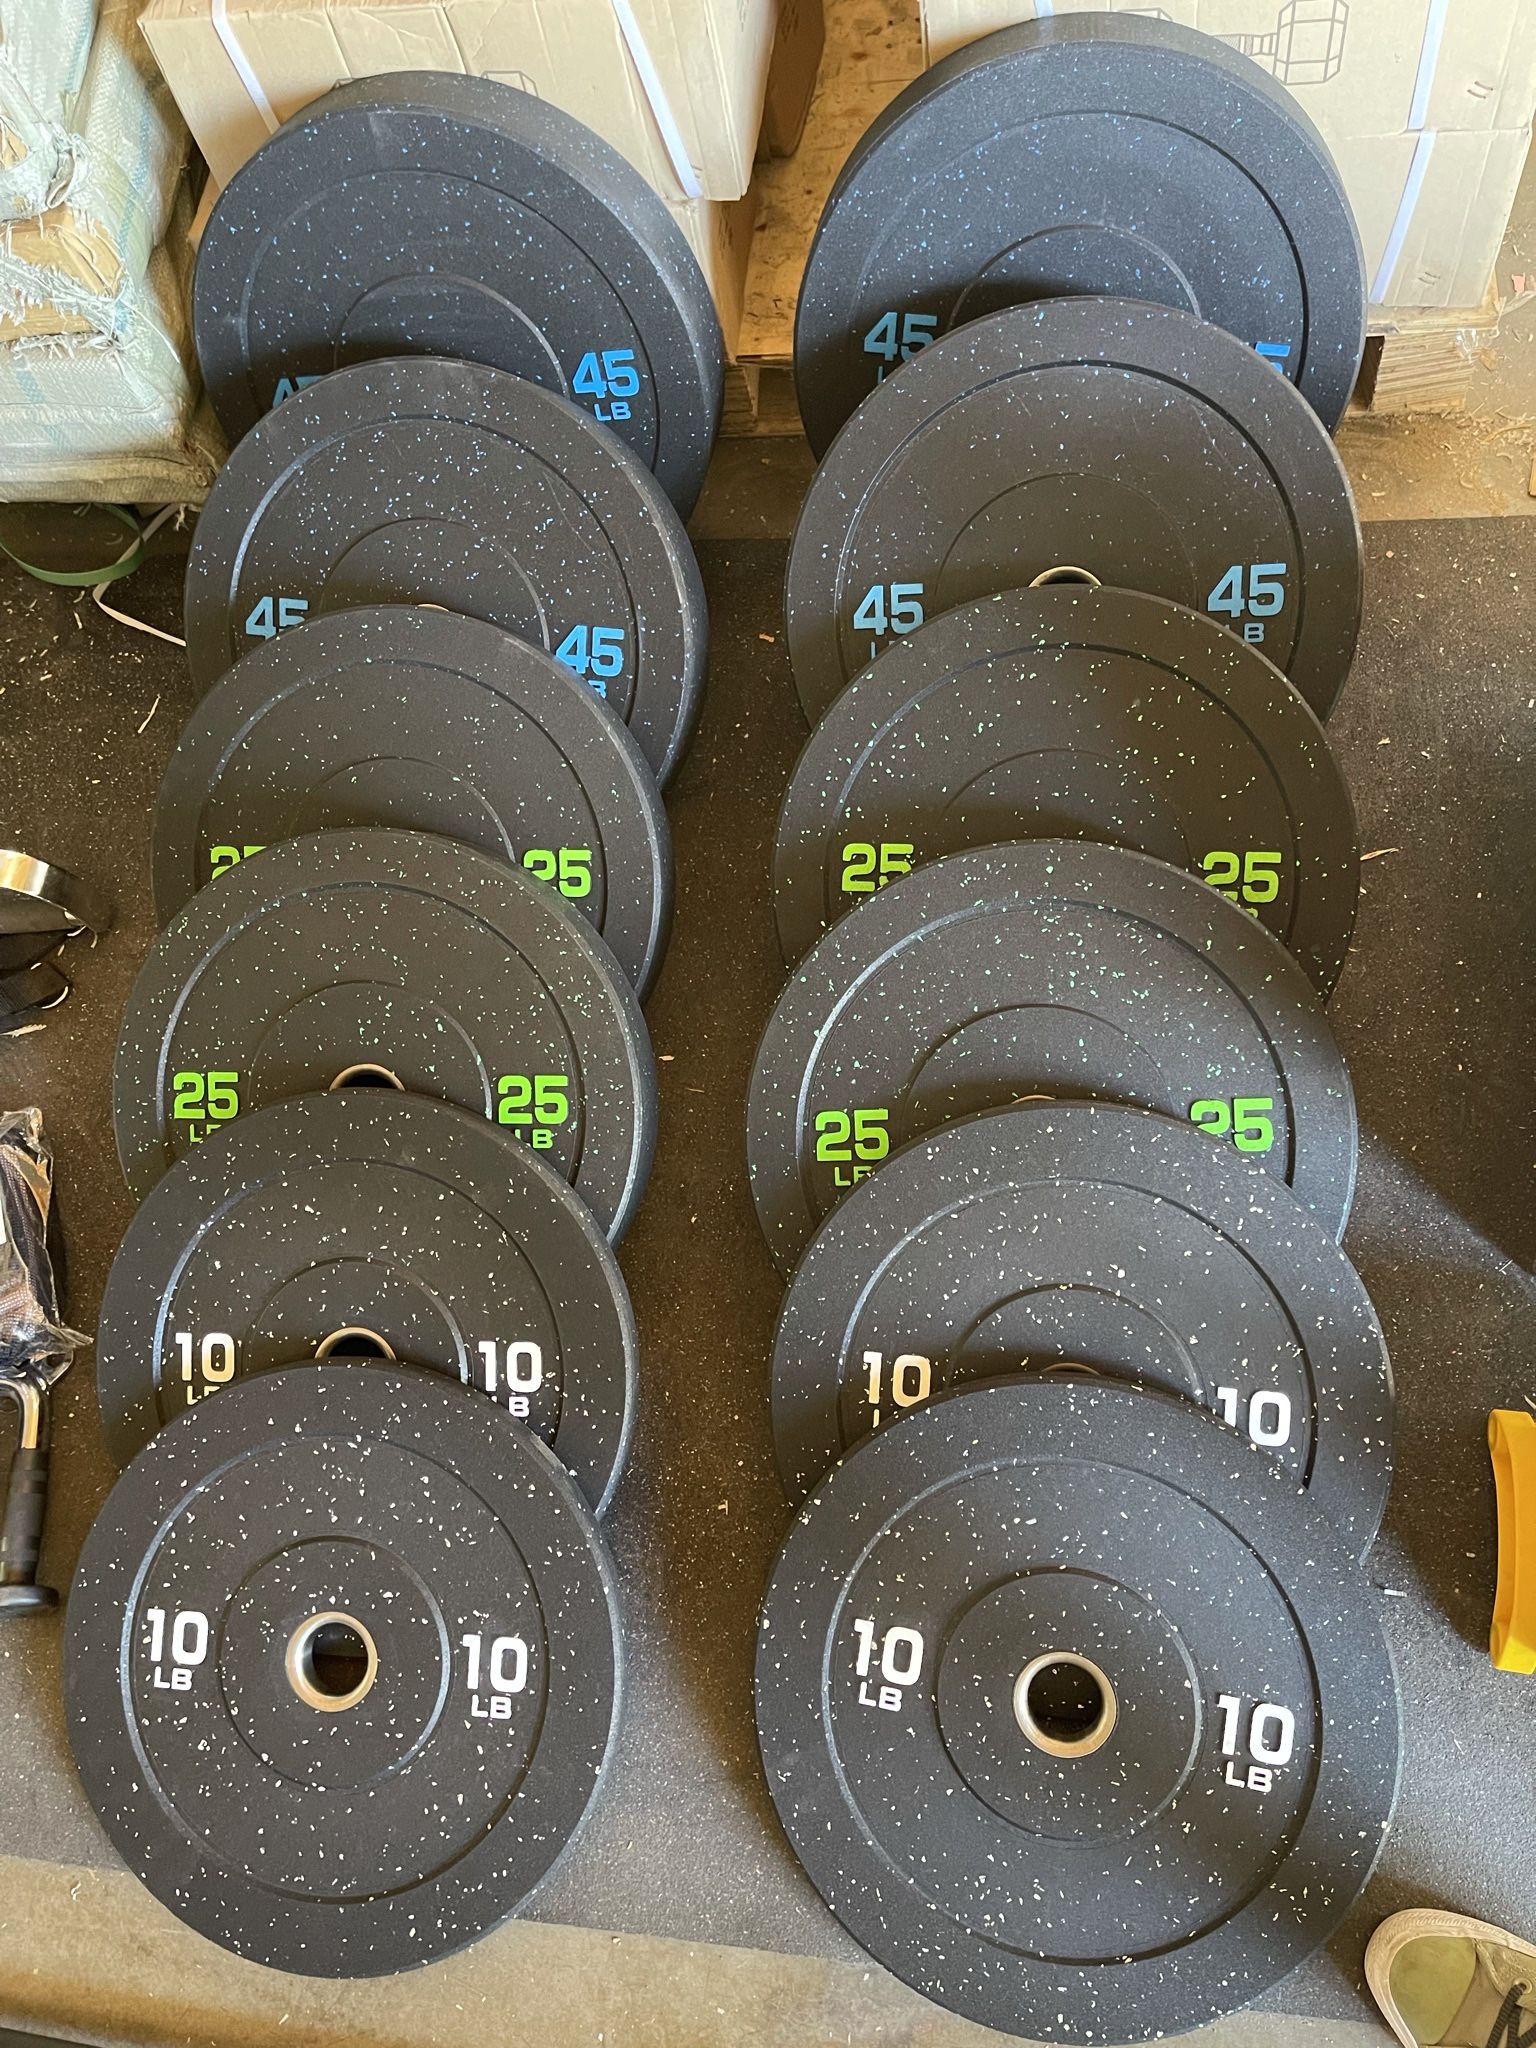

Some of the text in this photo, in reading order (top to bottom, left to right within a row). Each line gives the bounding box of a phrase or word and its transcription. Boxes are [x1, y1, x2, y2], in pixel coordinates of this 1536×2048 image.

[864, 312, 938, 361] 45
[572, 349, 640, 399] 45
[594, 401, 632, 421] LB
[853, 582, 924, 636] 45
[1207, 562, 1287, 618] 45
[555, 624, 625, 677] 45
[523, 849, 593, 898] 25
[841, 842, 915, 892] 25
[1202, 851, 1282, 904] 25
[173, 1071, 239, 1120] 25
[497, 1074, 569, 1125] 25
[815, 1109, 890, 1162] 25
[1190, 1096, 1274, 1153] 25
[175, 1332, 236, 1383] 10
[478, 1340, 542, 1393] 10
[863, 1350, 931, 1408] 10
[1217, 1386, 1292, 1447] 10
[147, 1608, 209, 1666] 10
[462, 1633, 528, 1693] 10
[854, 1618, 924, 1686] 10
[153, 1665, 193, 1691] LB
[858, 1681, 903, 1712] LB
[471, 1694, 512, 1720] LB
[1218, 1694, 1296, 1766] 10
[1225, 1760, 1273, 1793] LB
